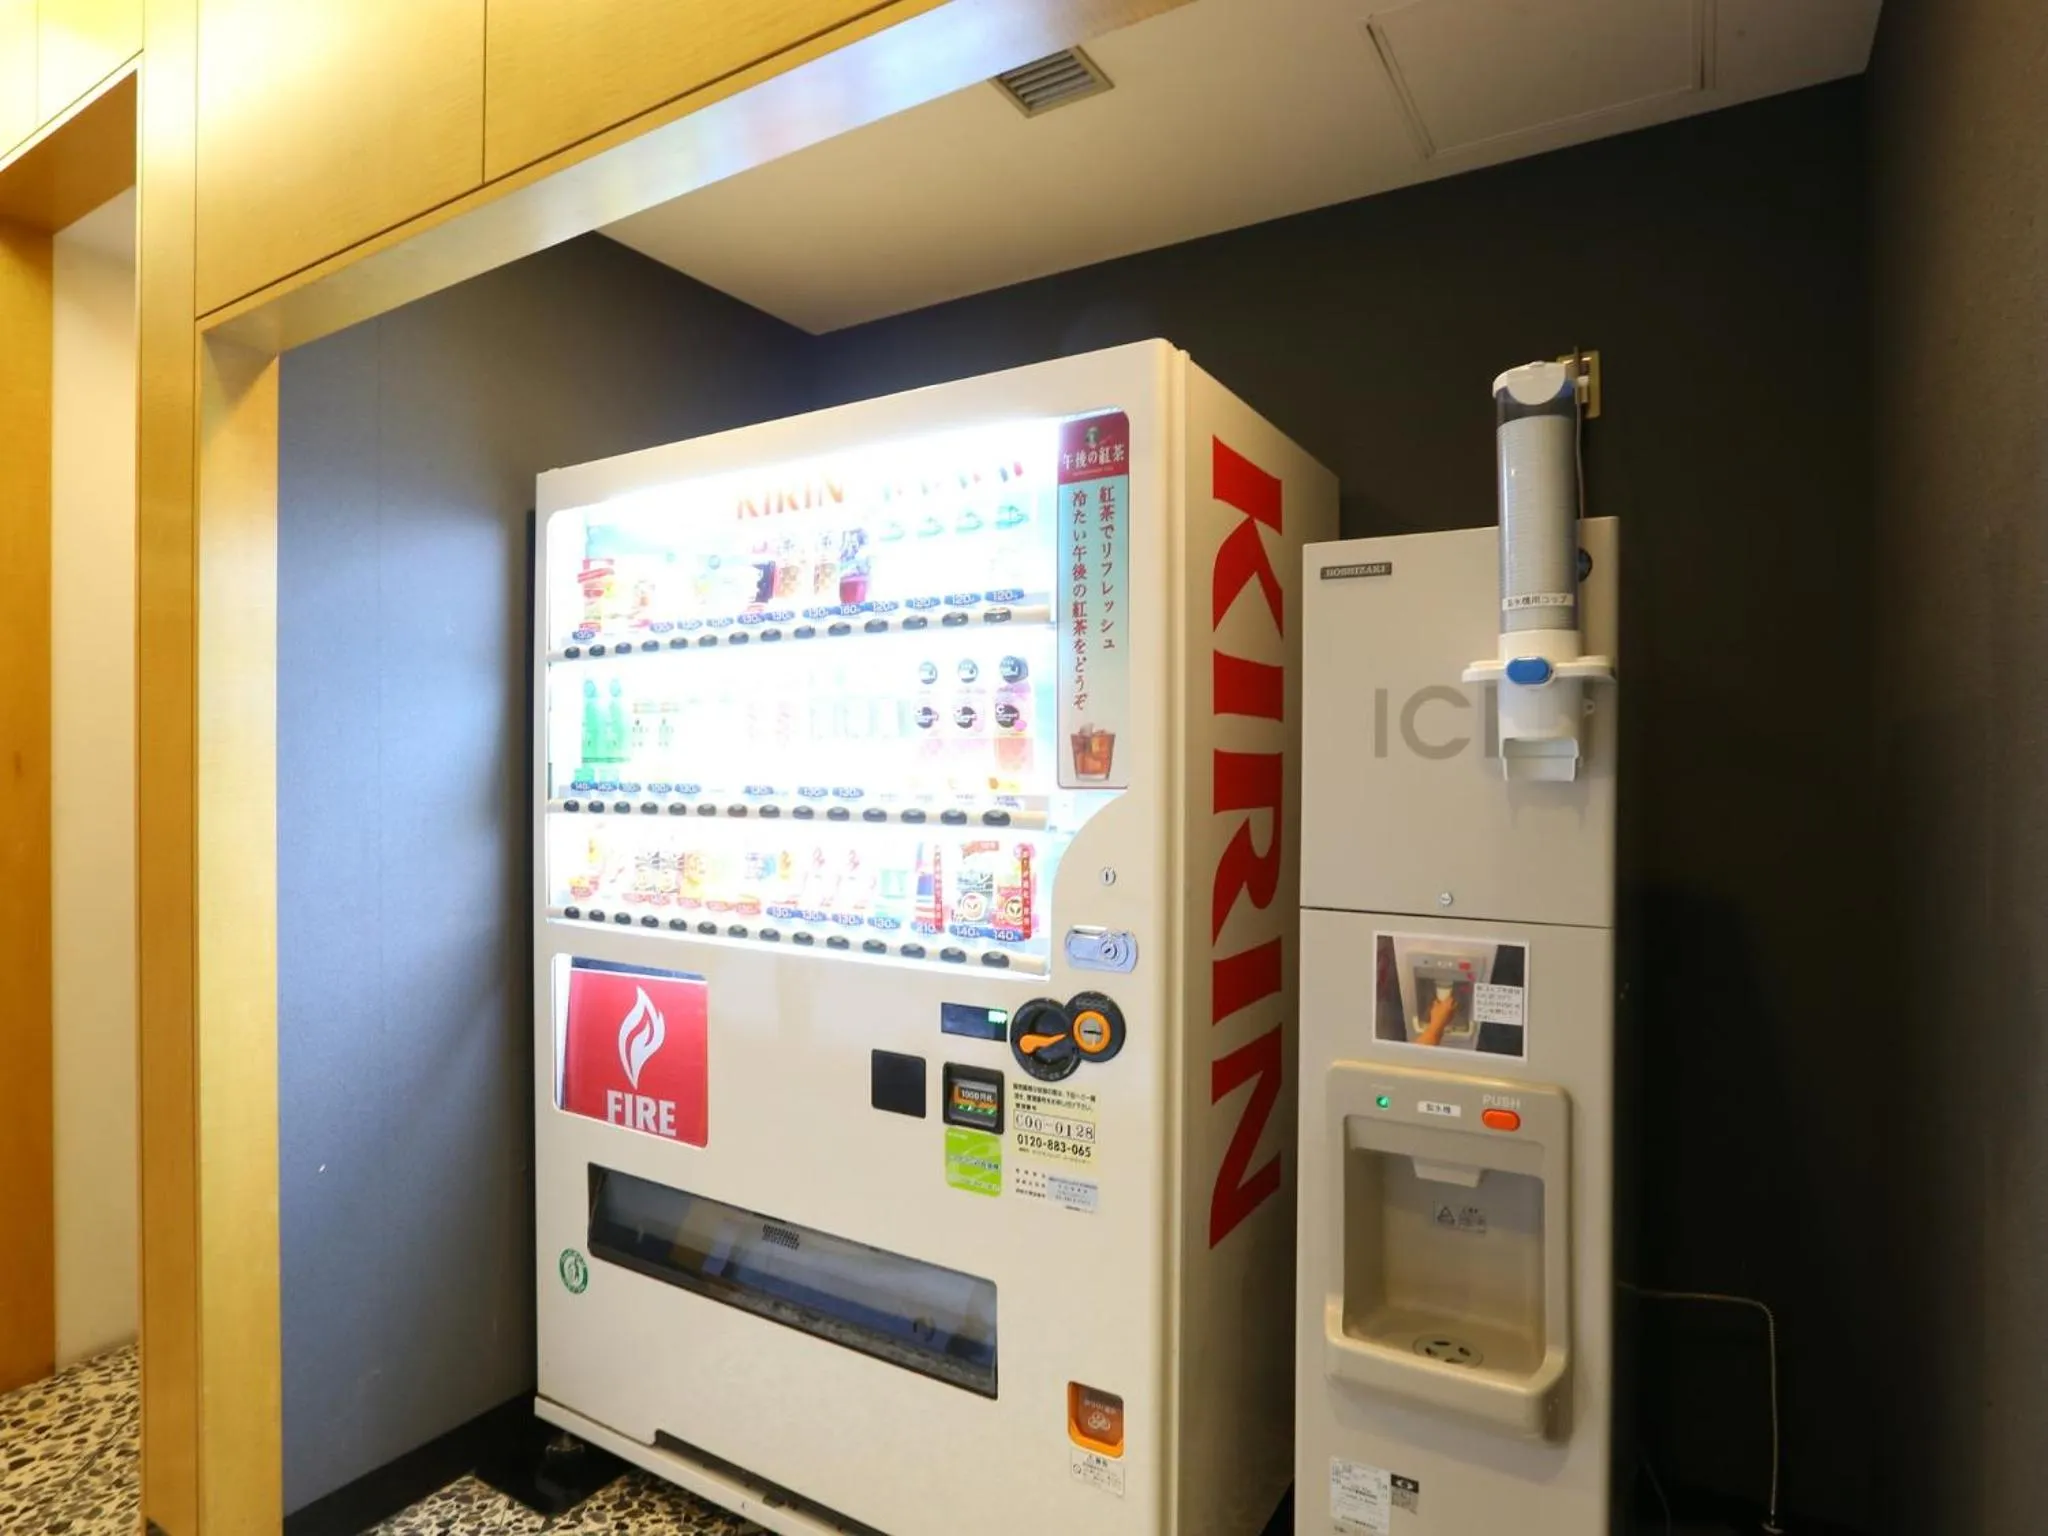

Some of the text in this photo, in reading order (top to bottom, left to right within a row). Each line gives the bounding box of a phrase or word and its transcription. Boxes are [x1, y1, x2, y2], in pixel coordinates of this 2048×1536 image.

[1063, 444, 1126, 471] 午後の紅茶
[1098, 485, 1116, 651] 紅茶でリフレッシュ
[1071, 489, 1089, 711] 冷たい午後の紅茶をどうぞ
[1210, 434, 1284, 1249] KIRIN
[606, 1089, 676, 1136] FIRE
[1482, 1094, 1521, 1109] PUSH
[1015, 1112, 1094, 1140] C00-0128
[1016, 1133, 1092, 1158] 0120-883-065
